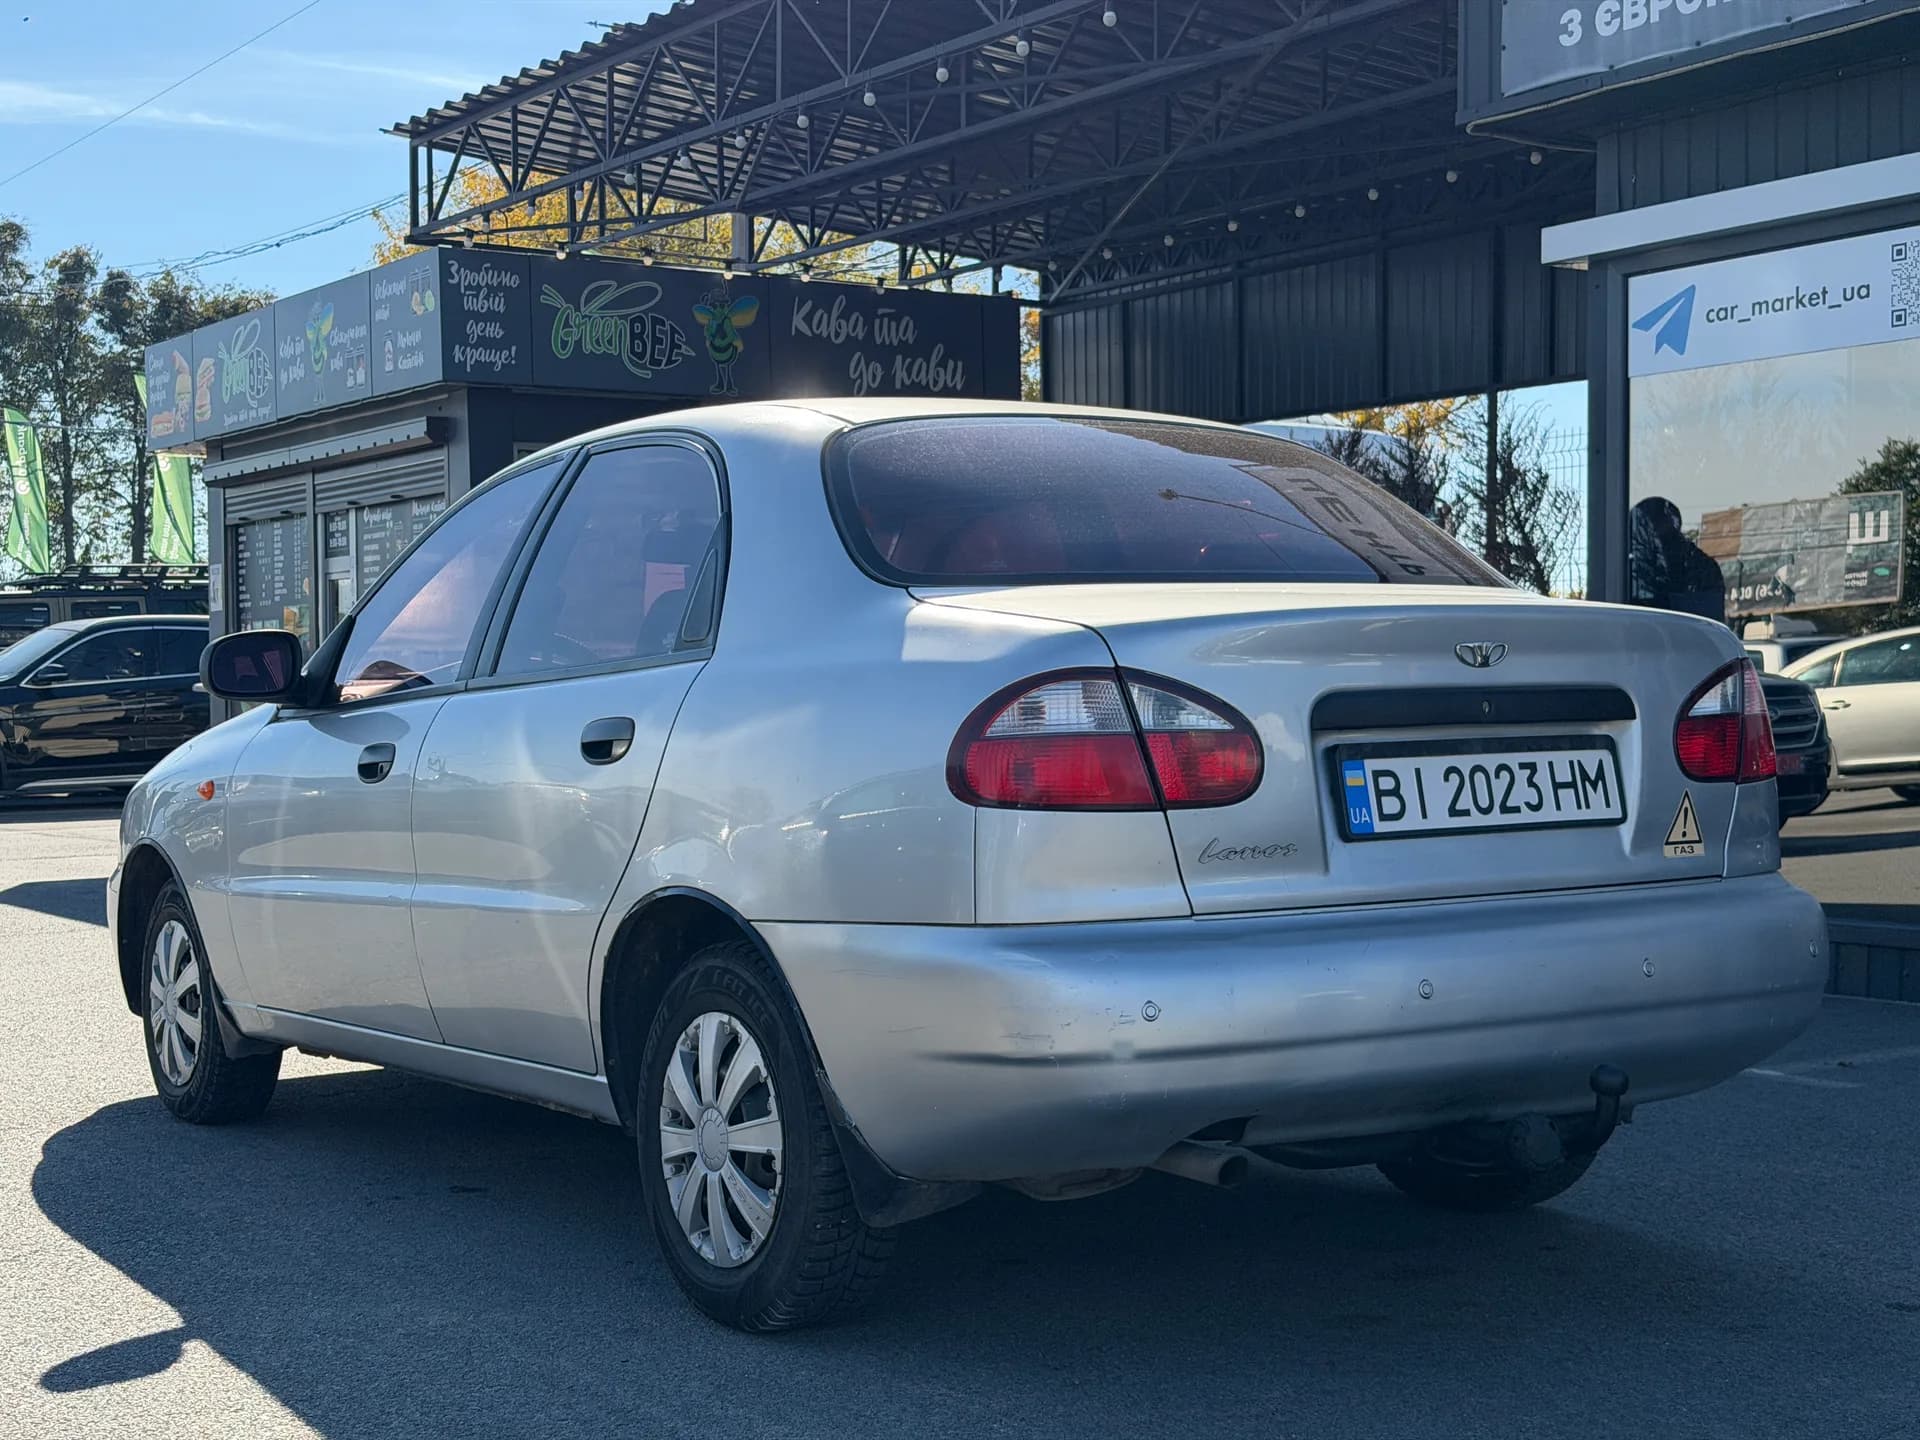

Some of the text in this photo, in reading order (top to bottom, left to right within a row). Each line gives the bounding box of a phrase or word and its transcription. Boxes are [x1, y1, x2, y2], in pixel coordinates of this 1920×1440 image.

[1559, 0, 1733, 46] З ЄВР
[448, 260, 520, 293] Зробимо
[463, 288, 507, 313] твій
[1706, 284, 1870, 323] car_market_ua
[466, 319, 504, 344] день
[791, 295, 918, 346] Кава та
[452, 345, 516, 372] краще!
[551, 304, 690, 379] GreenBEE
[850, 344, 966, 396] до кави
[1371, 758, 1612, 822] BI 2023 HM
[1349, 808, 1371, 825] UA
[1674, 846, 1695, 855] ГАЗ
